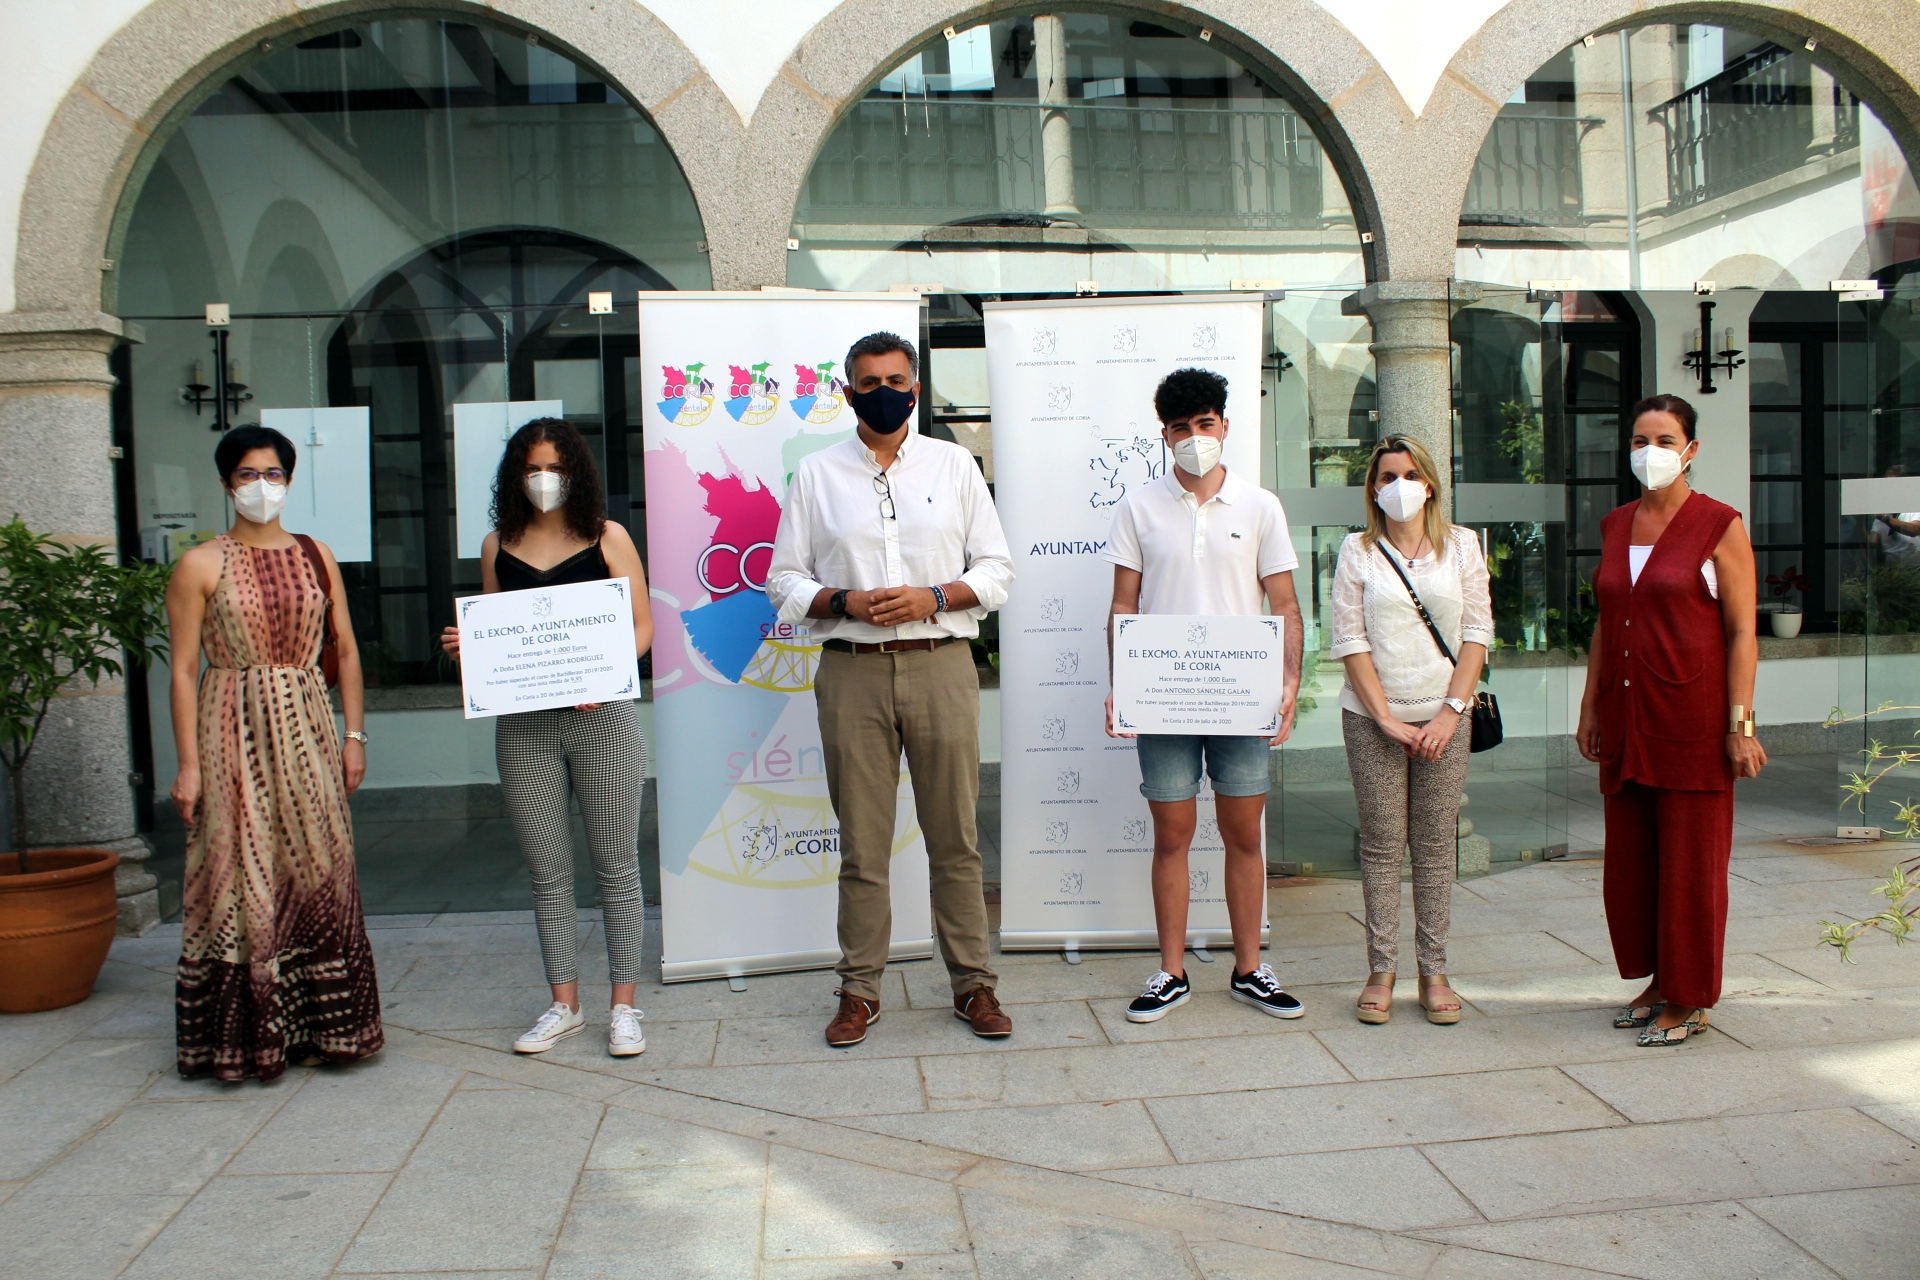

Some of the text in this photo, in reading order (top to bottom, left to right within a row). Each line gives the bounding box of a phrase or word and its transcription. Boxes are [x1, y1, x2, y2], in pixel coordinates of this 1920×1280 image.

[661, 381, 715, 399] CORIA
[727, 380, 780, 398] CORIA
[793, 379, 845, 397] CORIA
[1030, 541, 1106, 555] AYUNTAM
[474, 614, 617, 639] EL EXCMO. AYUNTAMIENTO
[522, 632, 570, 646] DE CORIA
[538, 659, 566, 667] PIZARRO
[567, 654, 604, 664] RODRÍGUEZ
[1142, 650, 1180, 658] EXCMO.
[1184, 650, 1268, 659] AYUNTAMIENTO
[584, 666, 613, 674] 2019/2020
[1174, 662, 1221, 671] DE CORIA
[785, 828, 839, 839] AYUNTAMIEN
[795, 838, 841, 855] CORI
